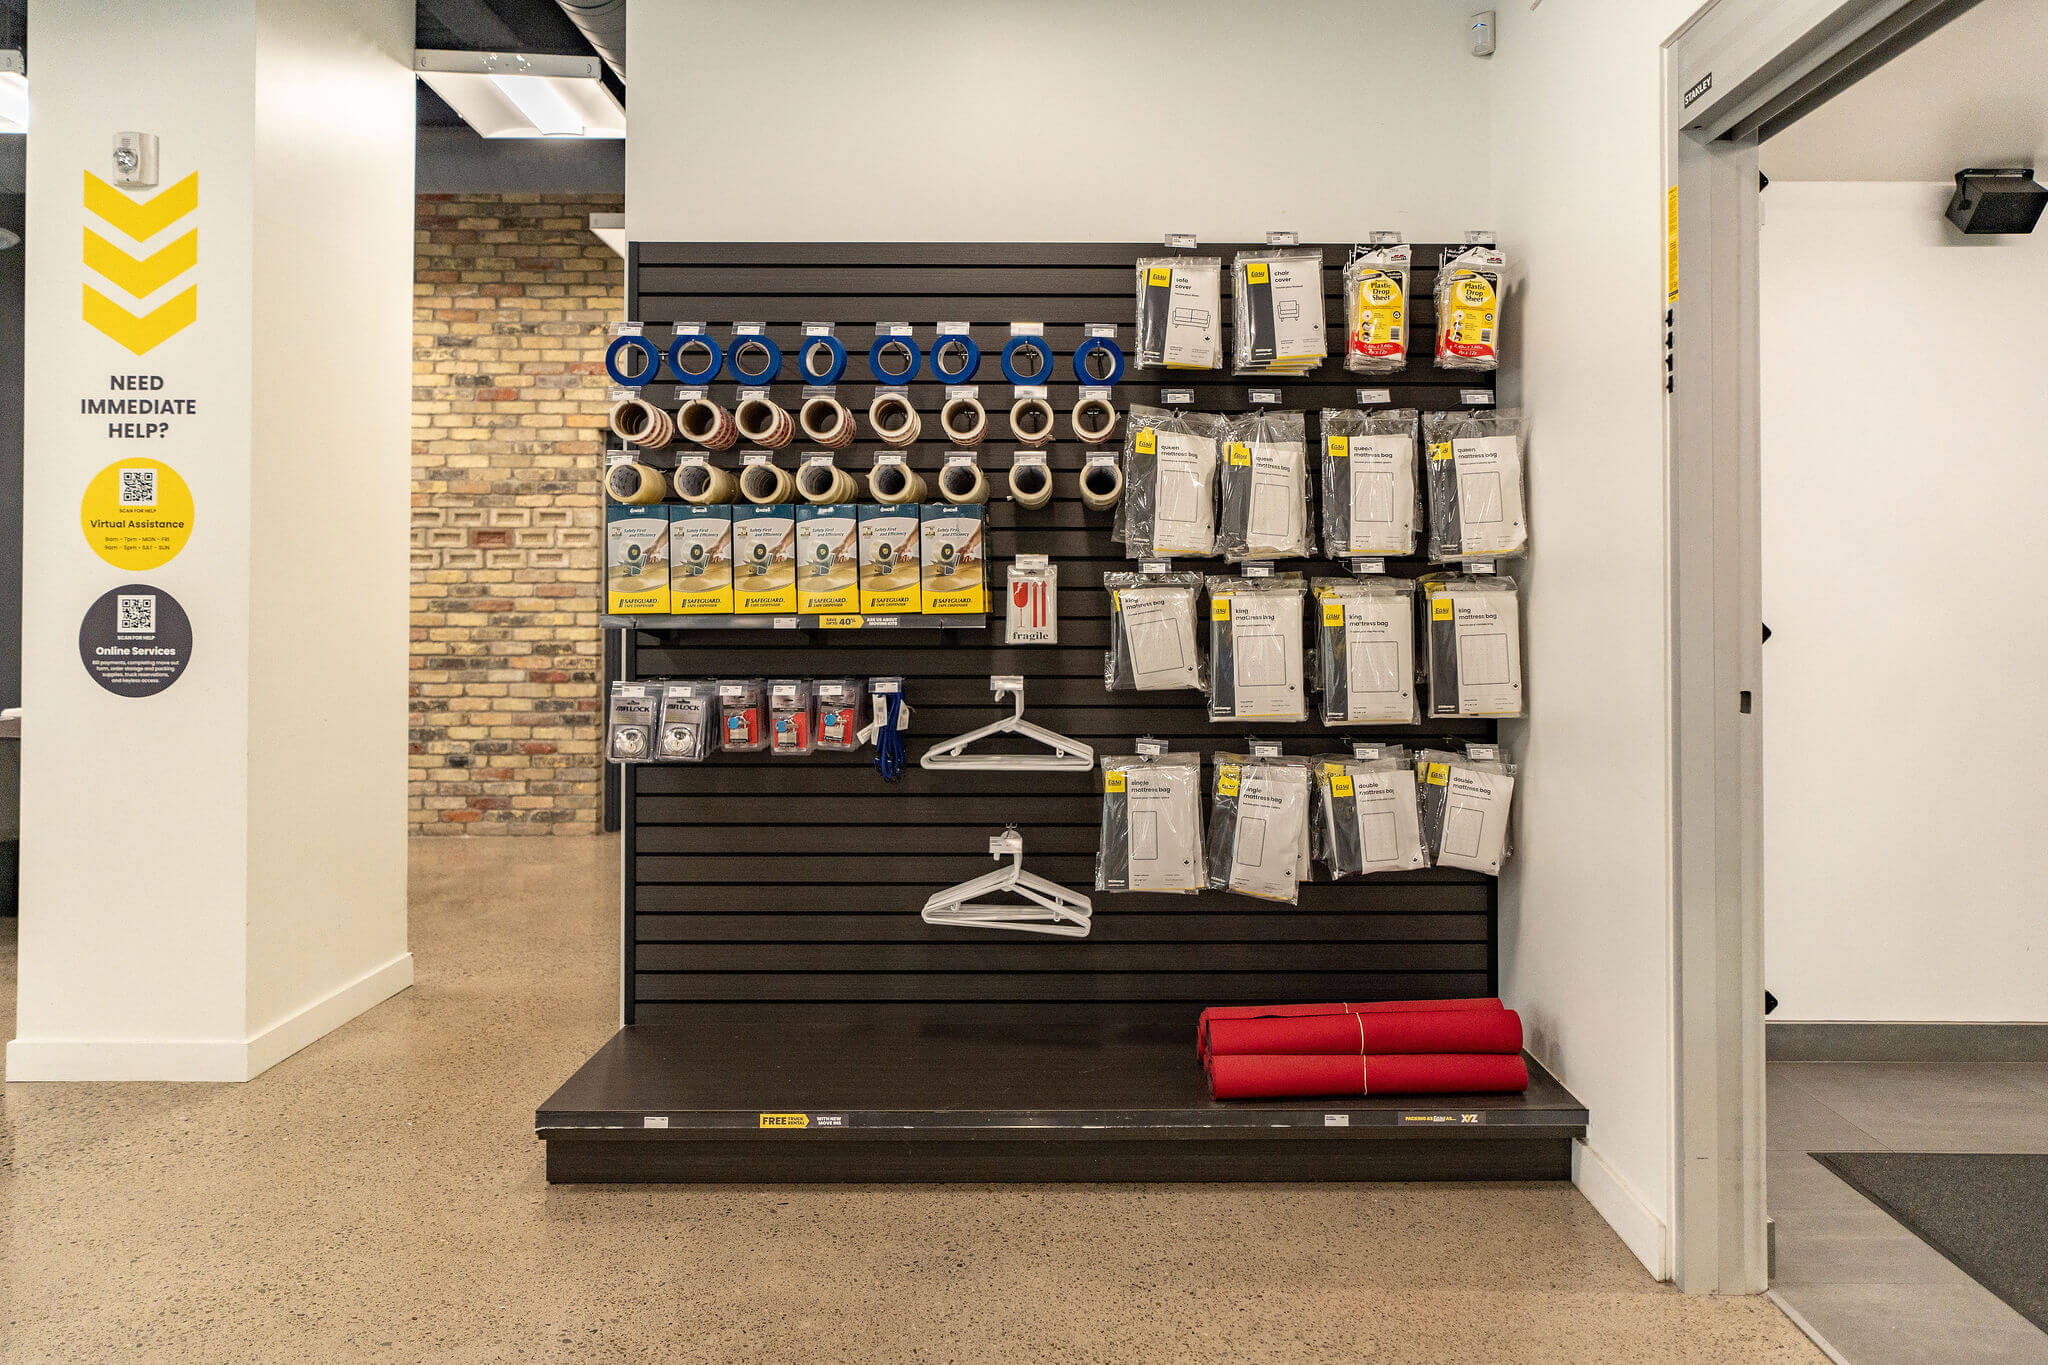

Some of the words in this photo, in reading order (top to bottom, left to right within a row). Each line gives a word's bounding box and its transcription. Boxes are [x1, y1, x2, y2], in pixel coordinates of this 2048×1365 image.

[1685, 76, 1711, 105] STANLEY
[1466, 289, 1483, 297] Drop
[110, 375, 164, 390] NEED
[81, 399, 196, 414] IMMEDIATE
[108, 422, 169, 438] HELP?
[90, 520, 126, 528] Virtual
[128, 520, 184, 528] Assistance
[1013, 631, 1049, 640] fragile
[96, 646, 130, 656] Online
[131, 646, 176, 656] Services
[1480, 787, 1491, 795] bag
[762, 1116, 787, 1125] FREE
